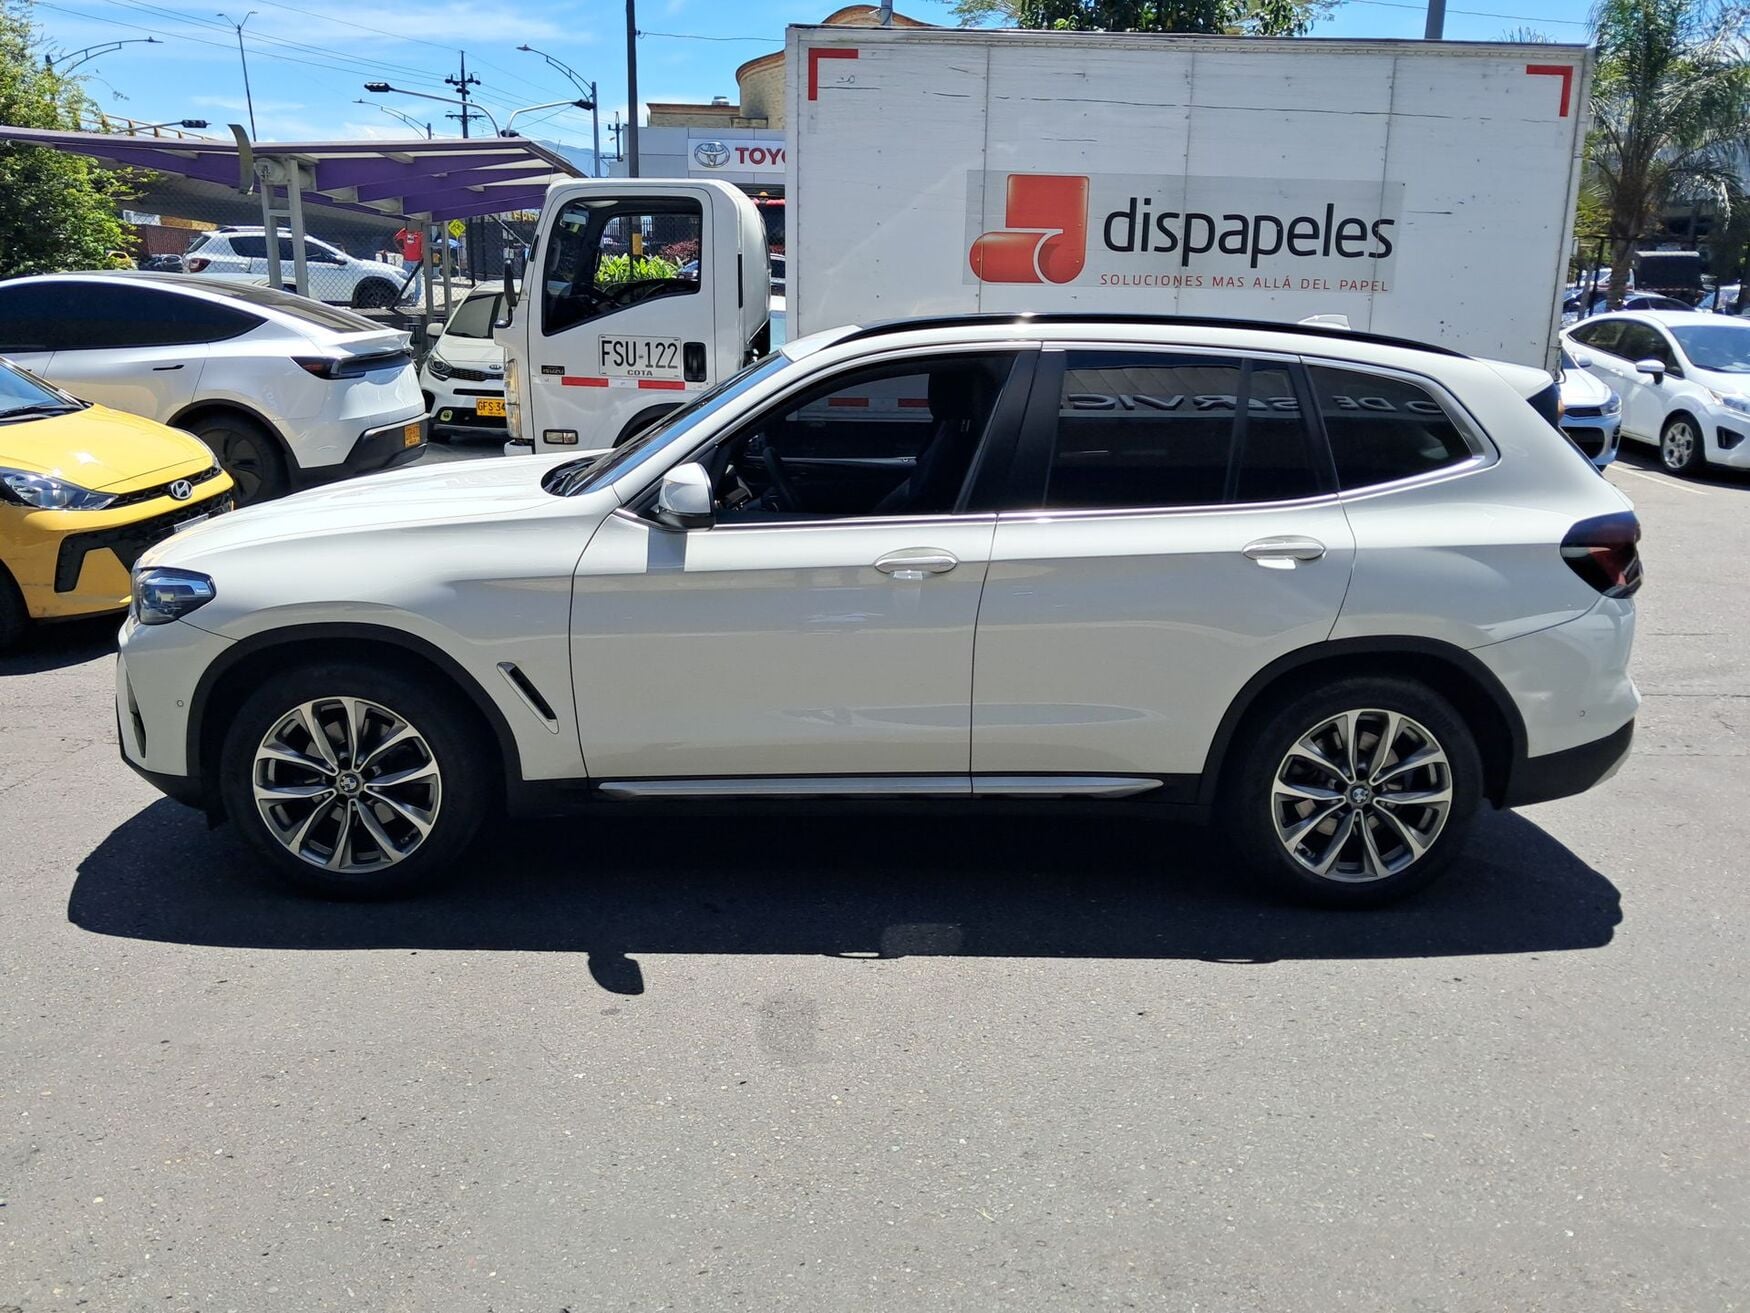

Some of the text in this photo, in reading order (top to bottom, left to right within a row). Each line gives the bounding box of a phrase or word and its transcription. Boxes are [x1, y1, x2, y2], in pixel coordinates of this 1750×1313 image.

[735, 146, 785, 165] TOY
[1104, 197, 1395, 268] dispapeles
[1101, 273, 1388, 292] SOLUCIONES MAS ALLÁ DEL PAPEL
[601, 339, 678, 369] FSU-122
[478, 401, 493, 411] GFS
